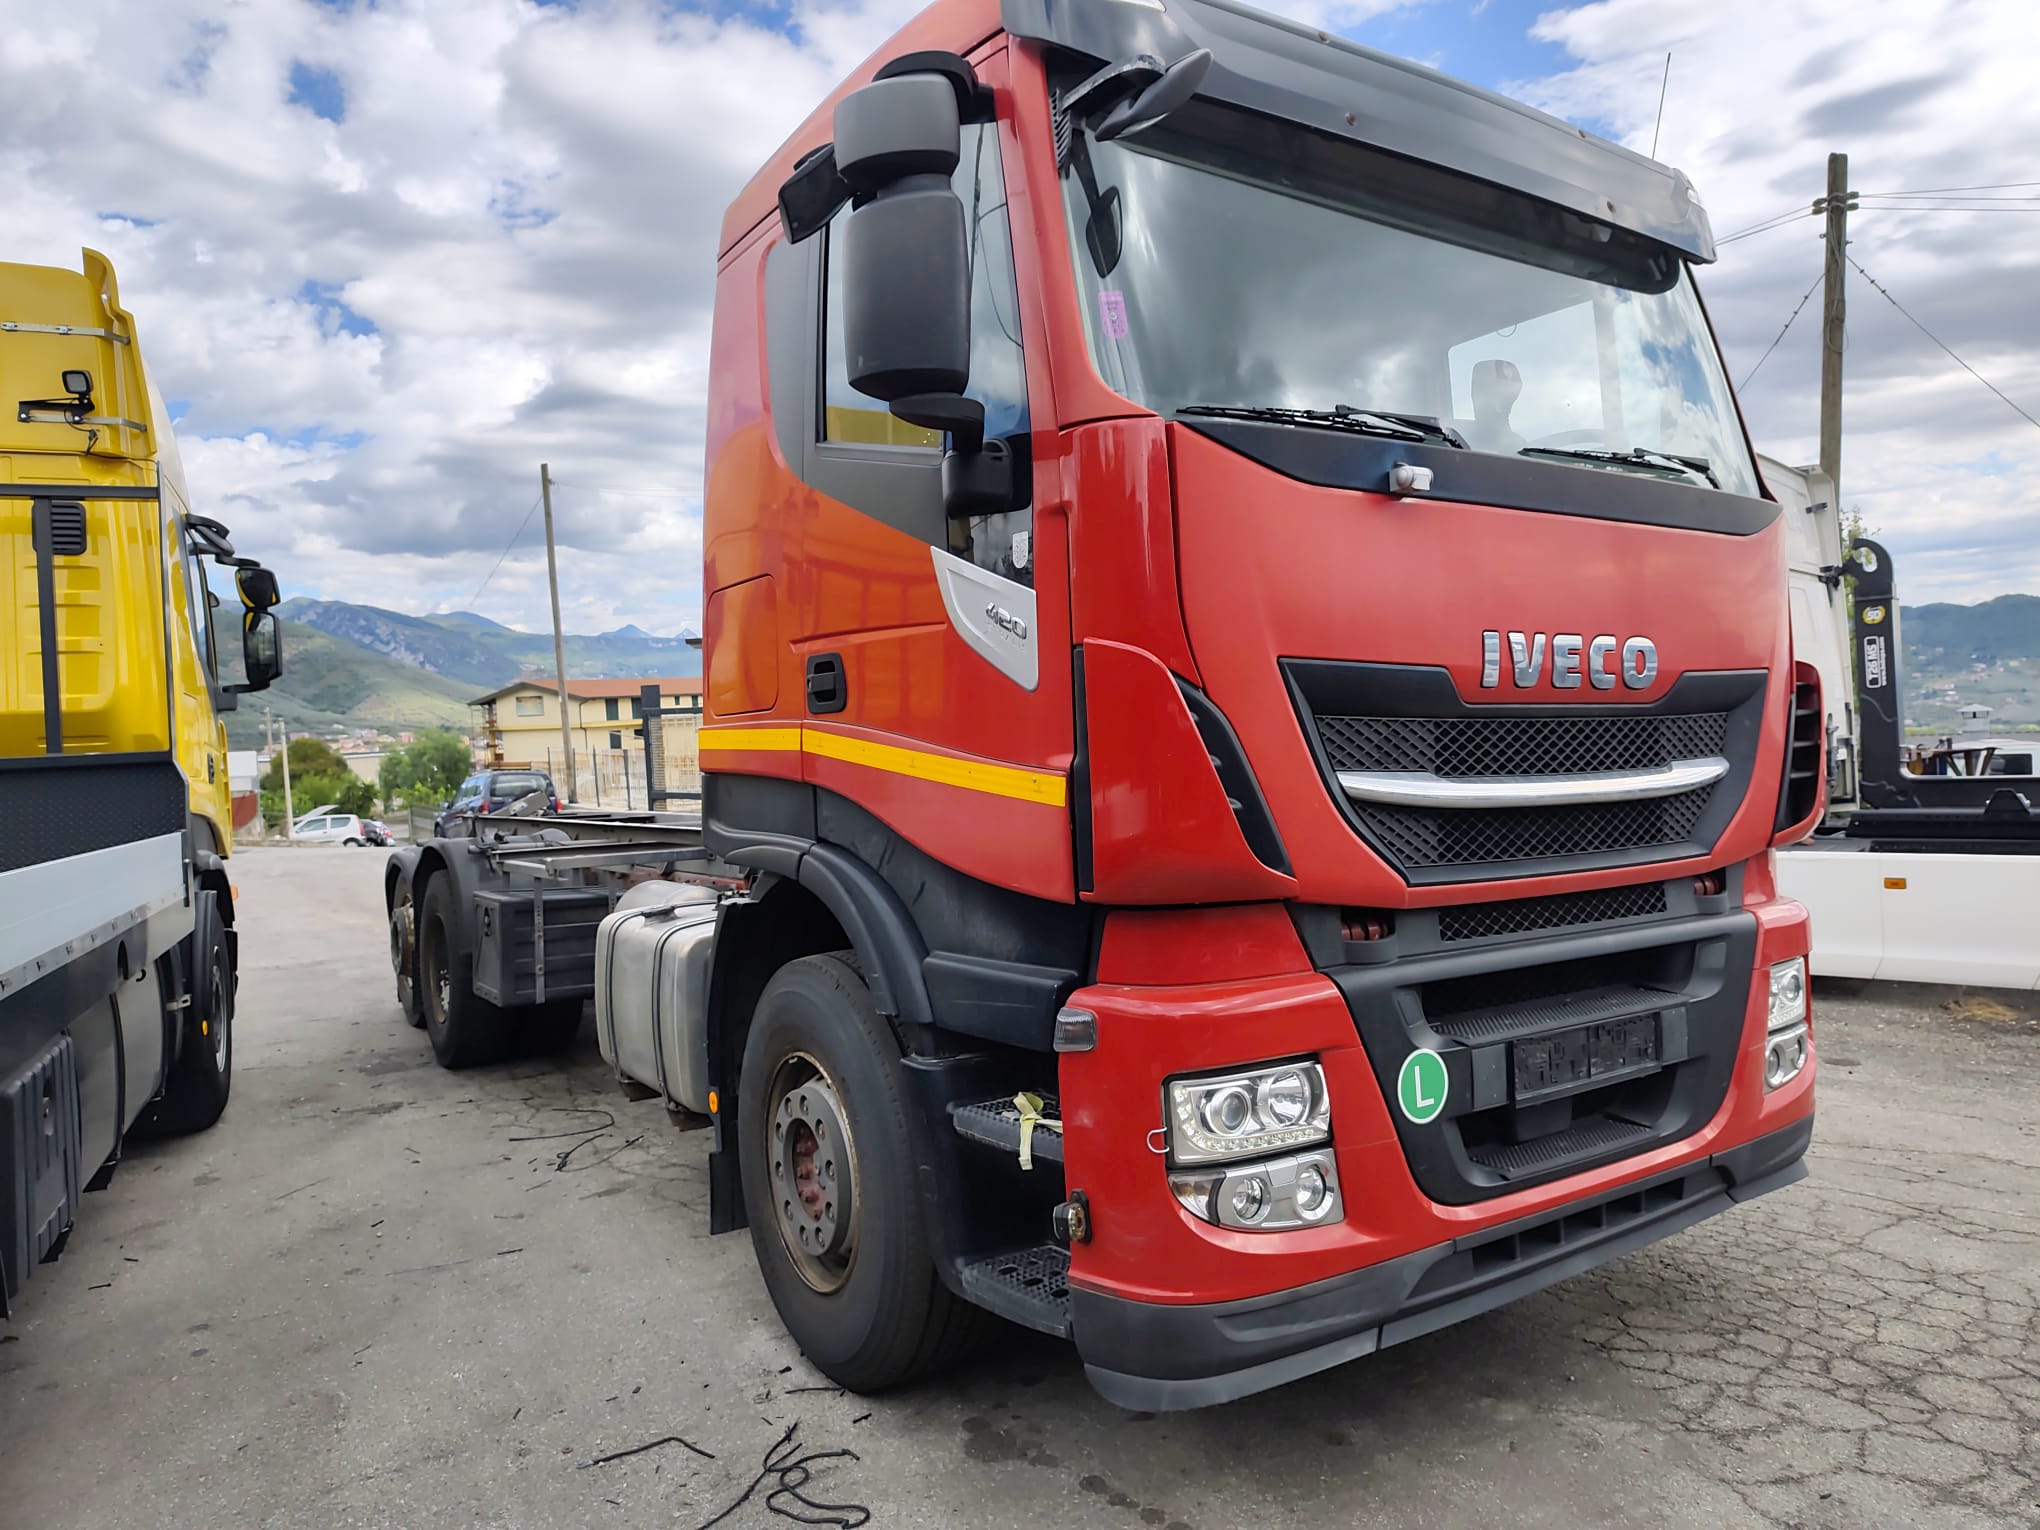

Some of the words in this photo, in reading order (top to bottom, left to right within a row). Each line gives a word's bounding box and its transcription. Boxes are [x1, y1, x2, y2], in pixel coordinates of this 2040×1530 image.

[986, 603, 1027, 640] 420
[1482, 630, 1658, 690] IVECO
[1414, 1065, 1435, 1108] L
